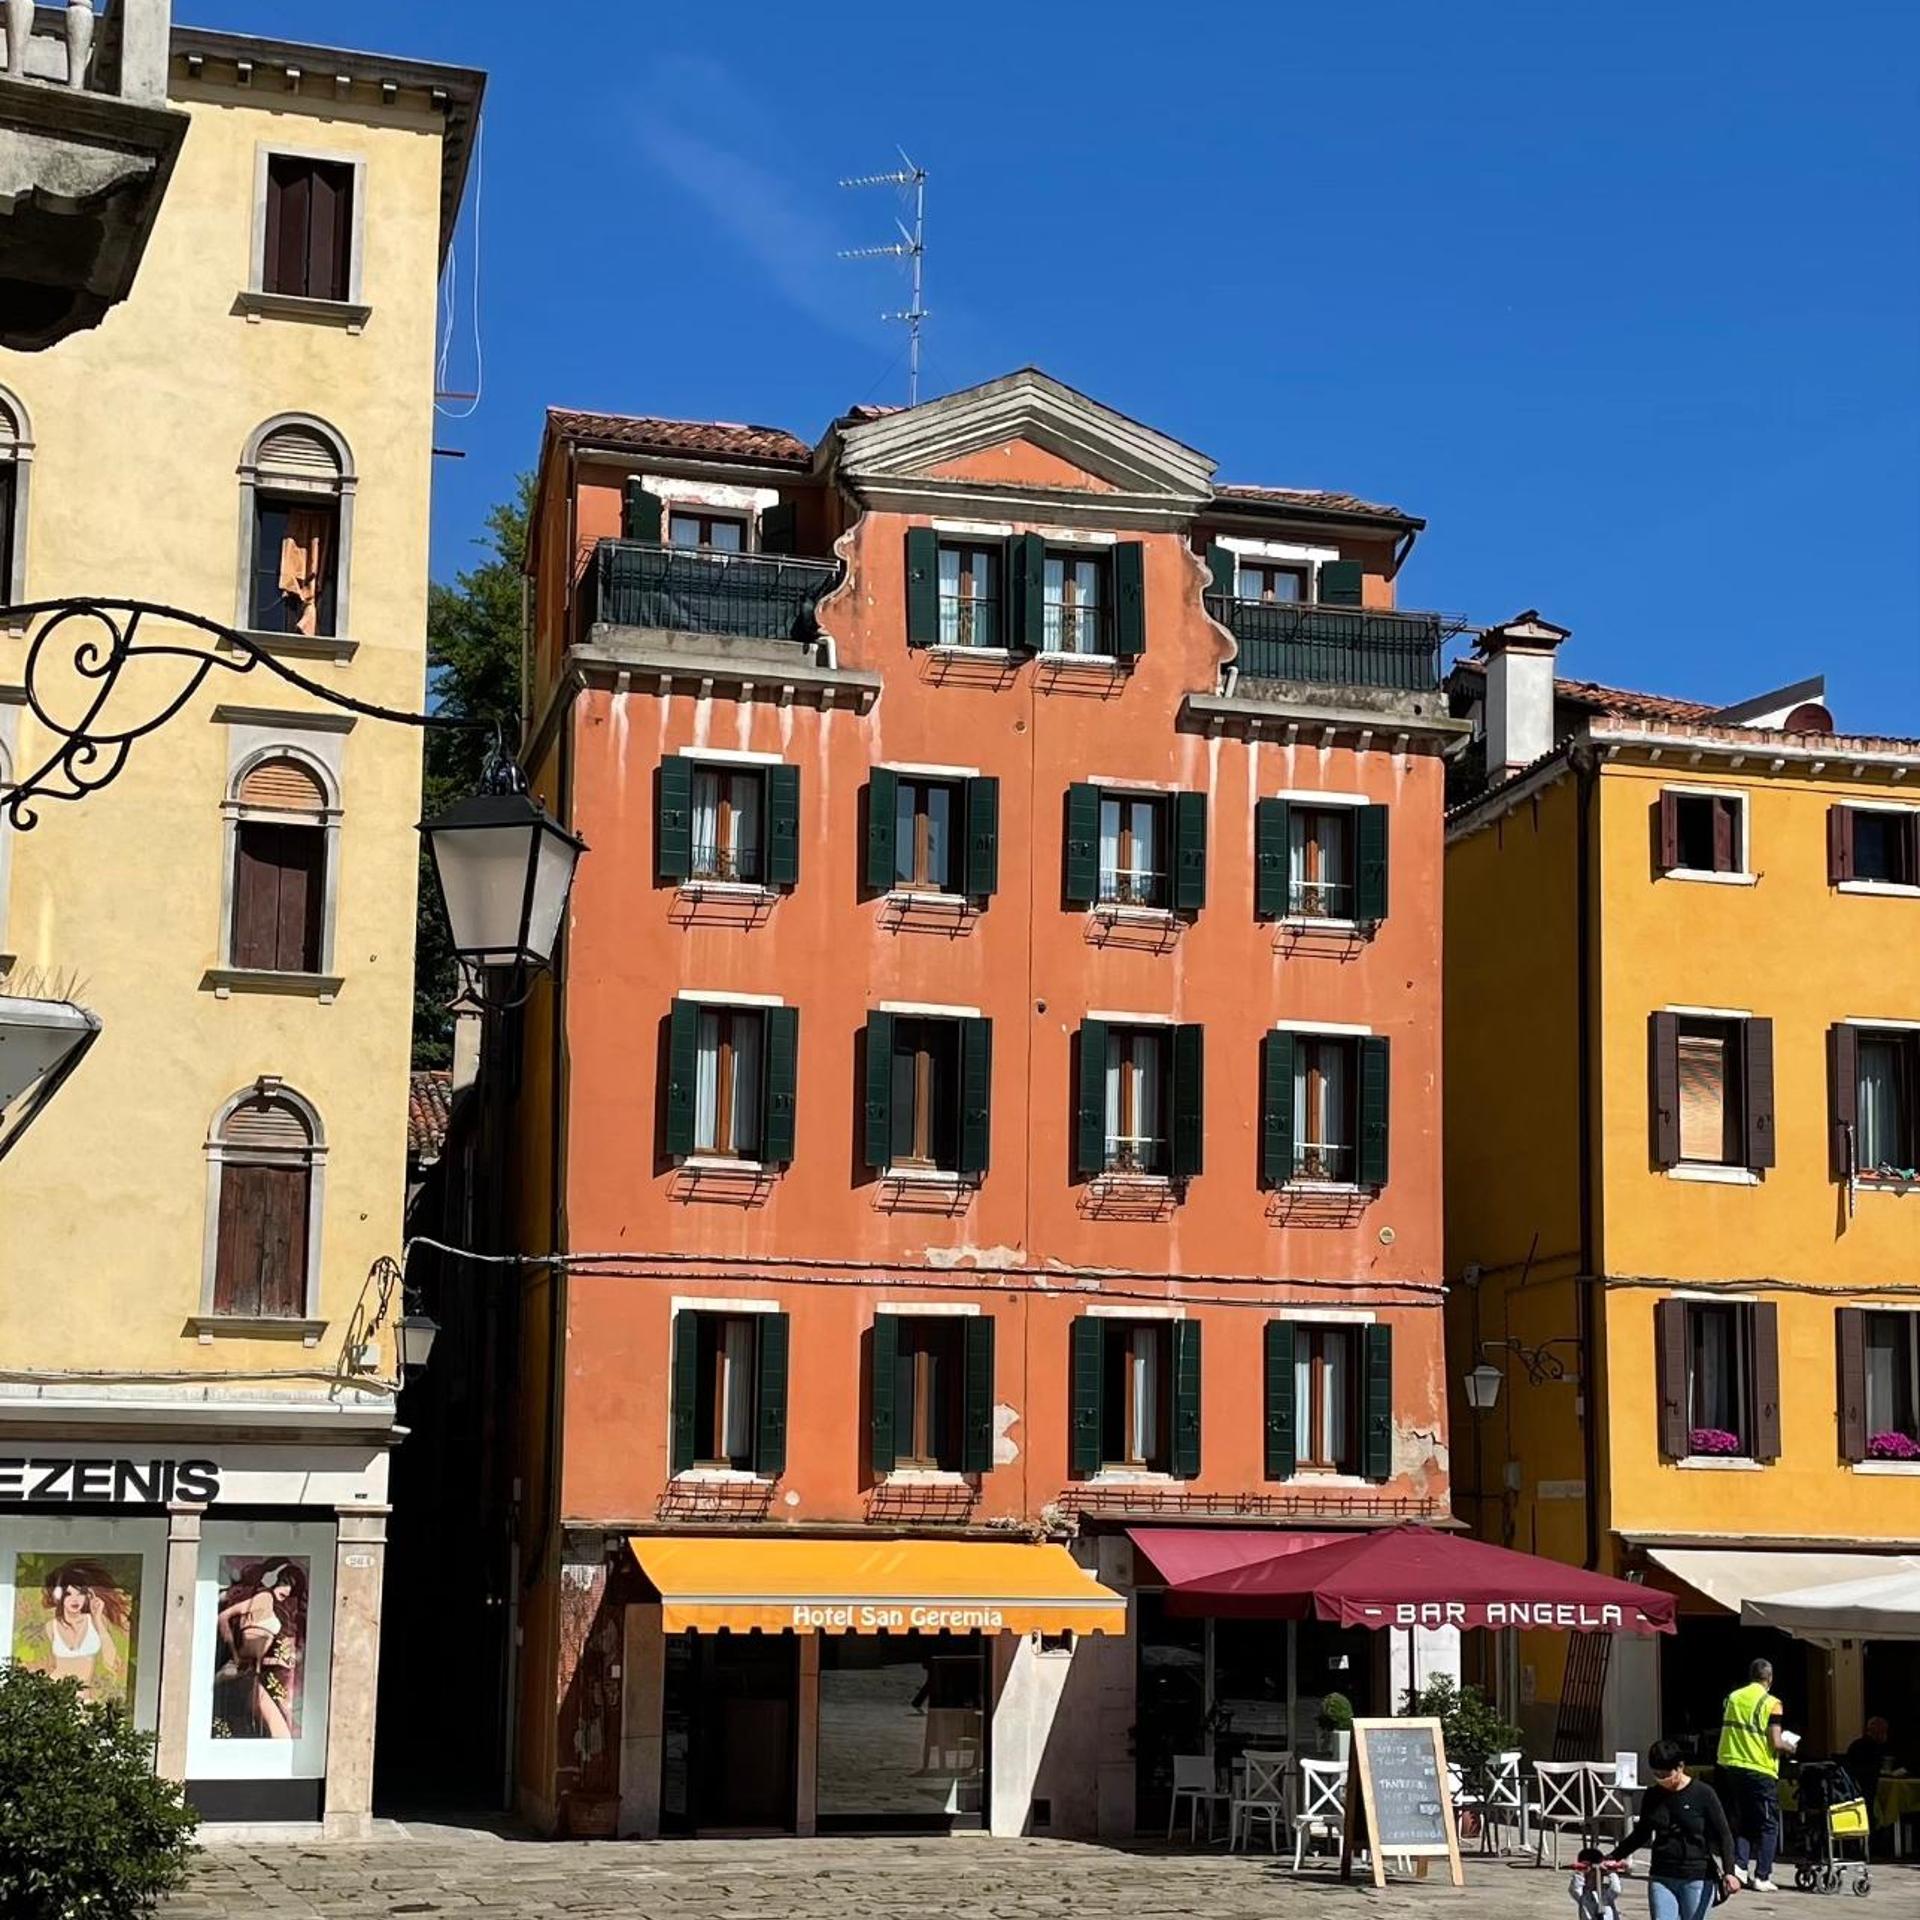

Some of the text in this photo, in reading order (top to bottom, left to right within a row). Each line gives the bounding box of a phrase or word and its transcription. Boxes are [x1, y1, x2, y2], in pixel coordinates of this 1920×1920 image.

[793, 1605, 1003, 1626] Hotel San Geremia
[1396, 1603, 1622, 1626] BAR ANGELA
